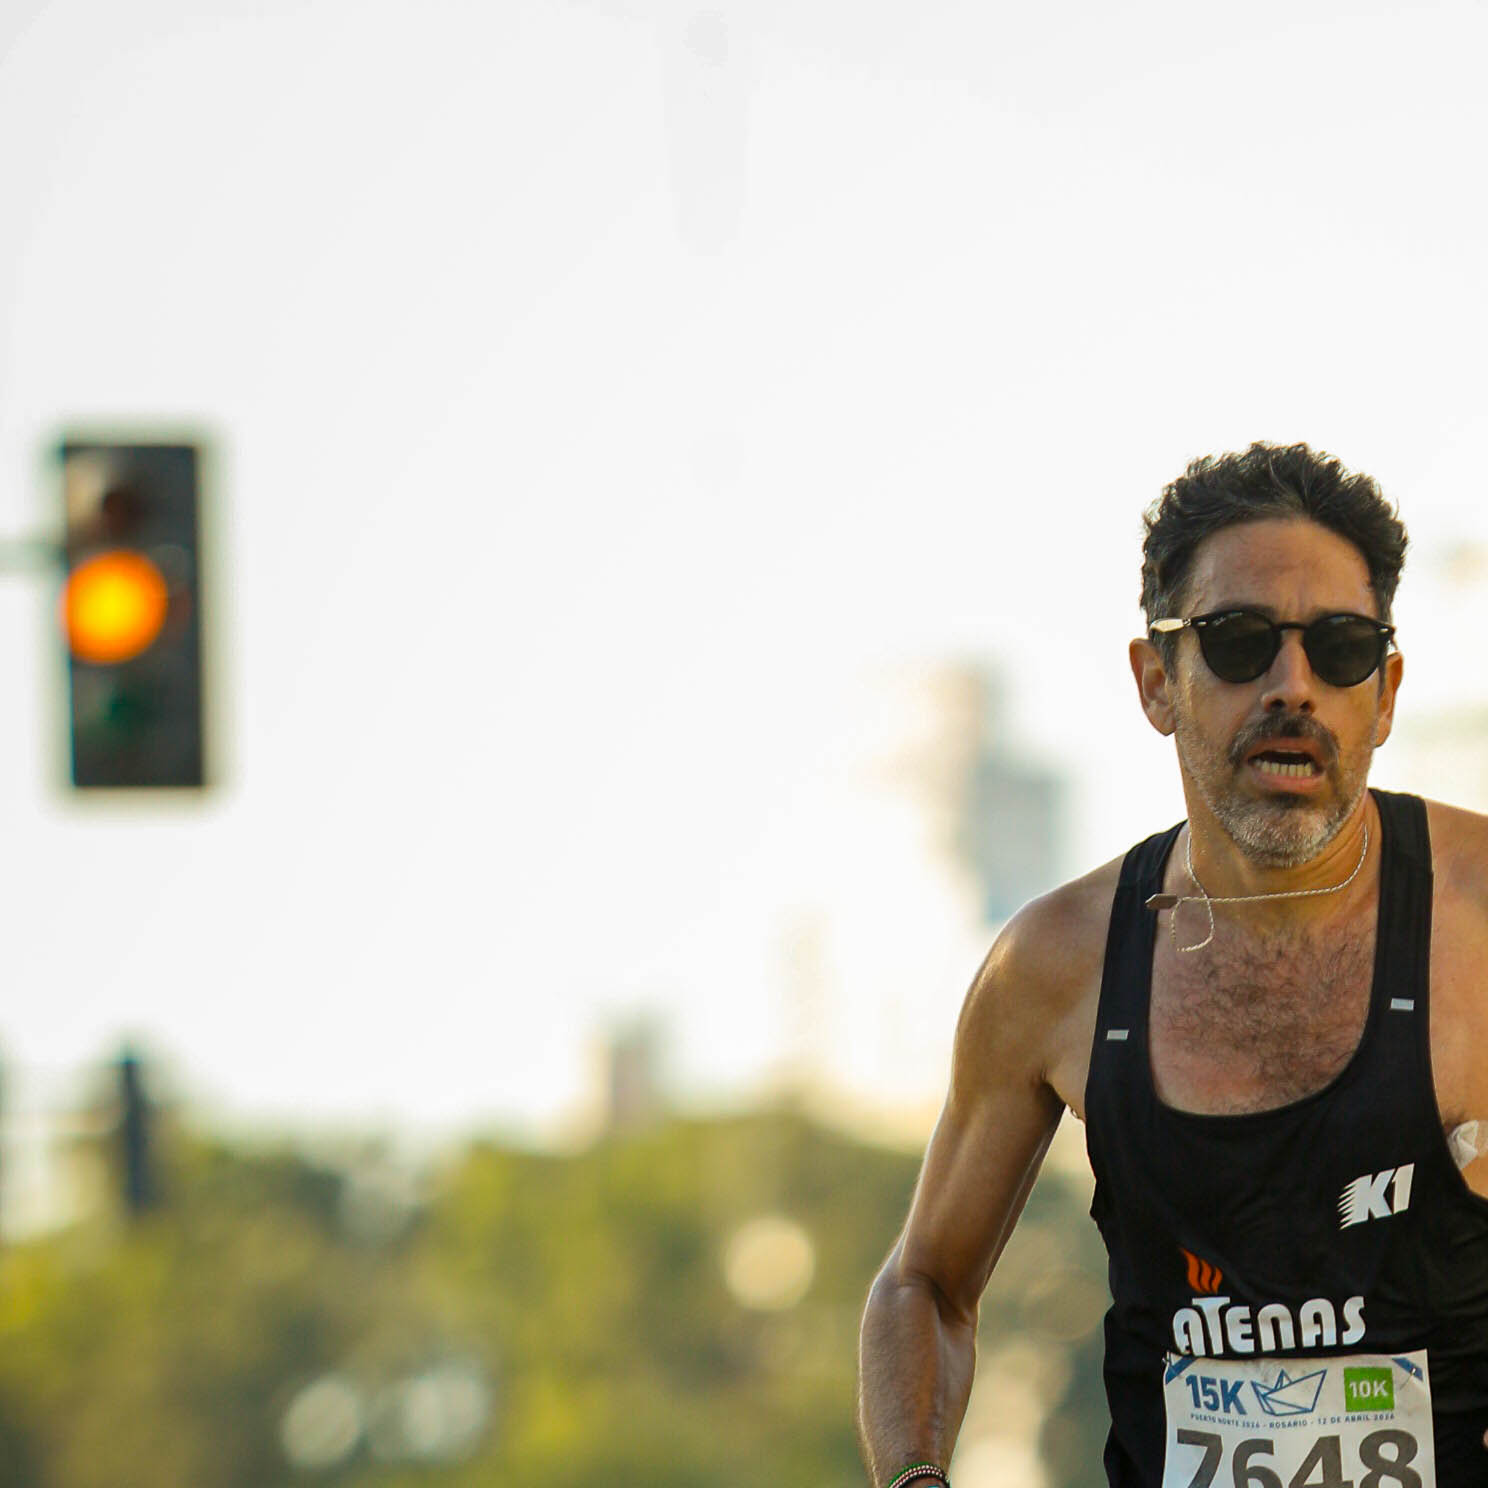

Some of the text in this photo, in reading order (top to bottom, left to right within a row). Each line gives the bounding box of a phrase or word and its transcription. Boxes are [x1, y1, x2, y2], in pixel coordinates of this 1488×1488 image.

[1337, 1162, 1415, 1231] K1
[1172, 1295, 1366, 1357] ATENAS
[1185, 1374, 1248, 1416] 15K
[1348, 1379, 1390, 1399] 10K
[1268, 1420, 1308, 1430] ROSARIO
[1330, 1415, 1342, 1425] DE
